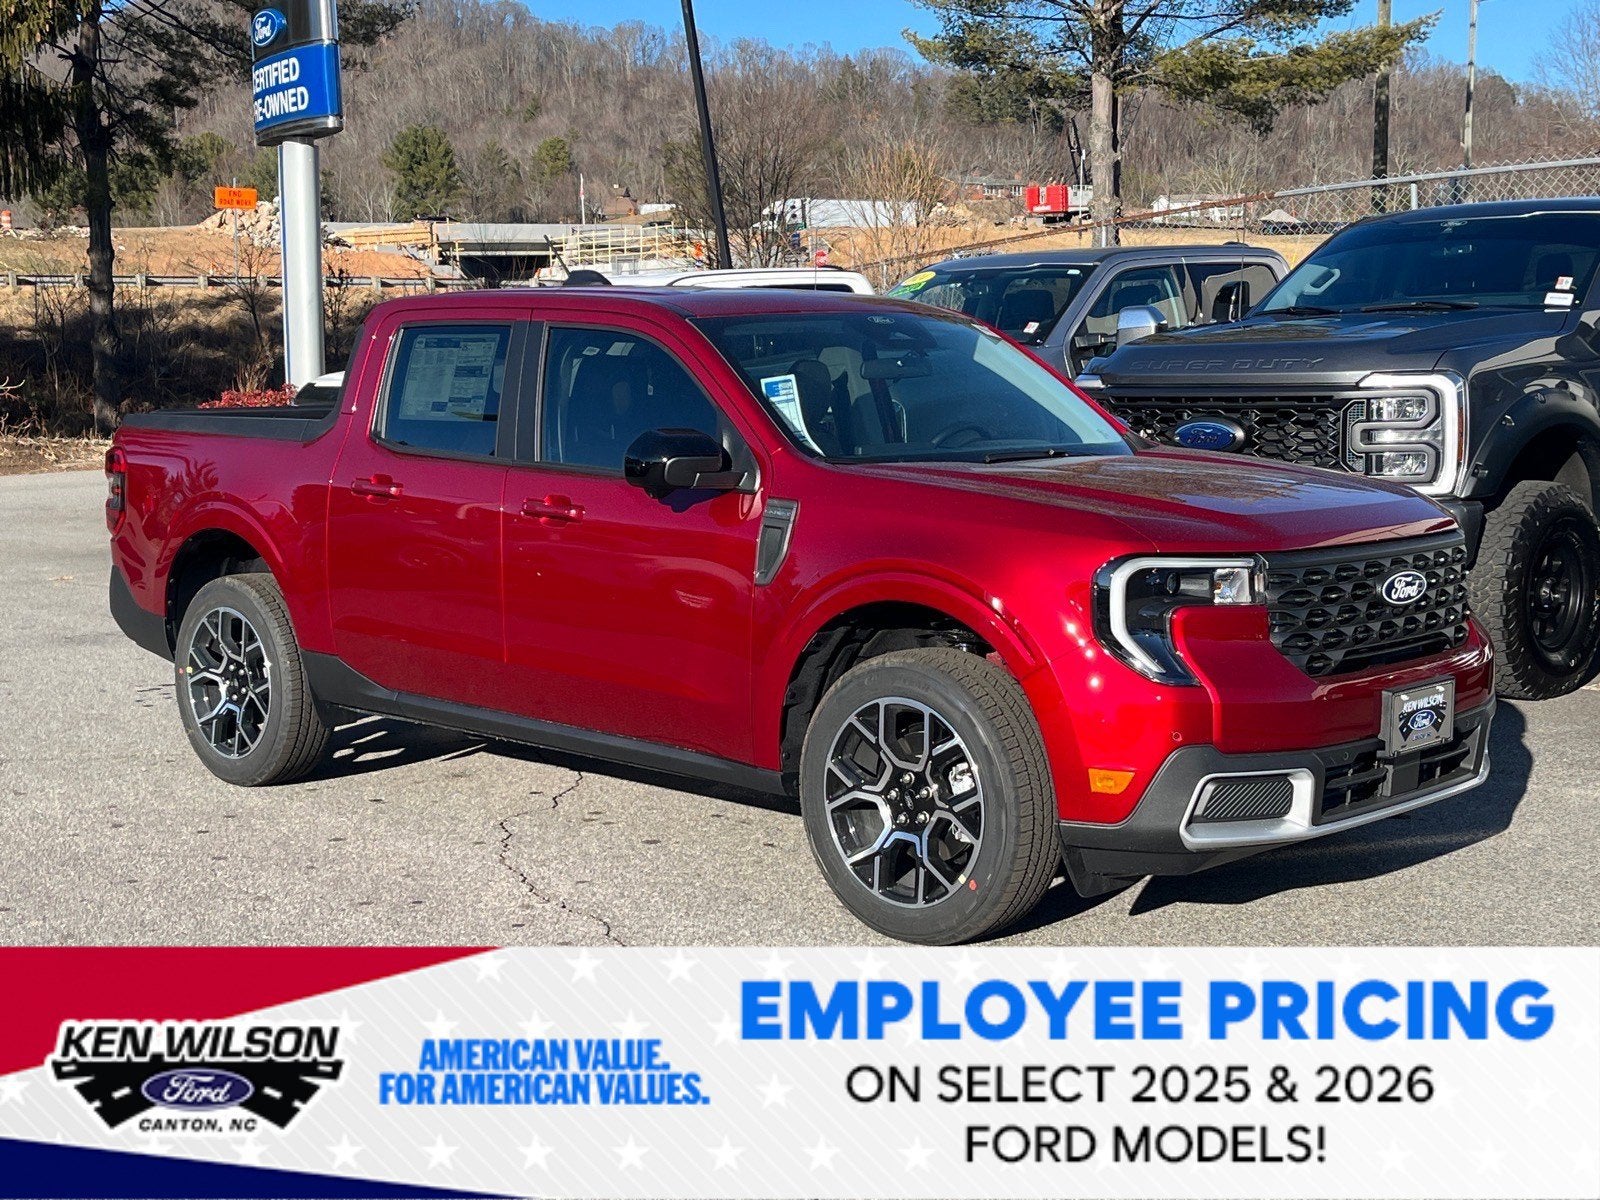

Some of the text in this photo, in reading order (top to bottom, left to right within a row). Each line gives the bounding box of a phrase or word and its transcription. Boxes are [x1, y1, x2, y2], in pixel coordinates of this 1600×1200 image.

[254, 16, 271, 42] Ford
[1129, 357, 1325, 371] SUPER DUTY
[1391, 575, 1419, 600] Ford
[1413, 712, 1432, 728] Ford
